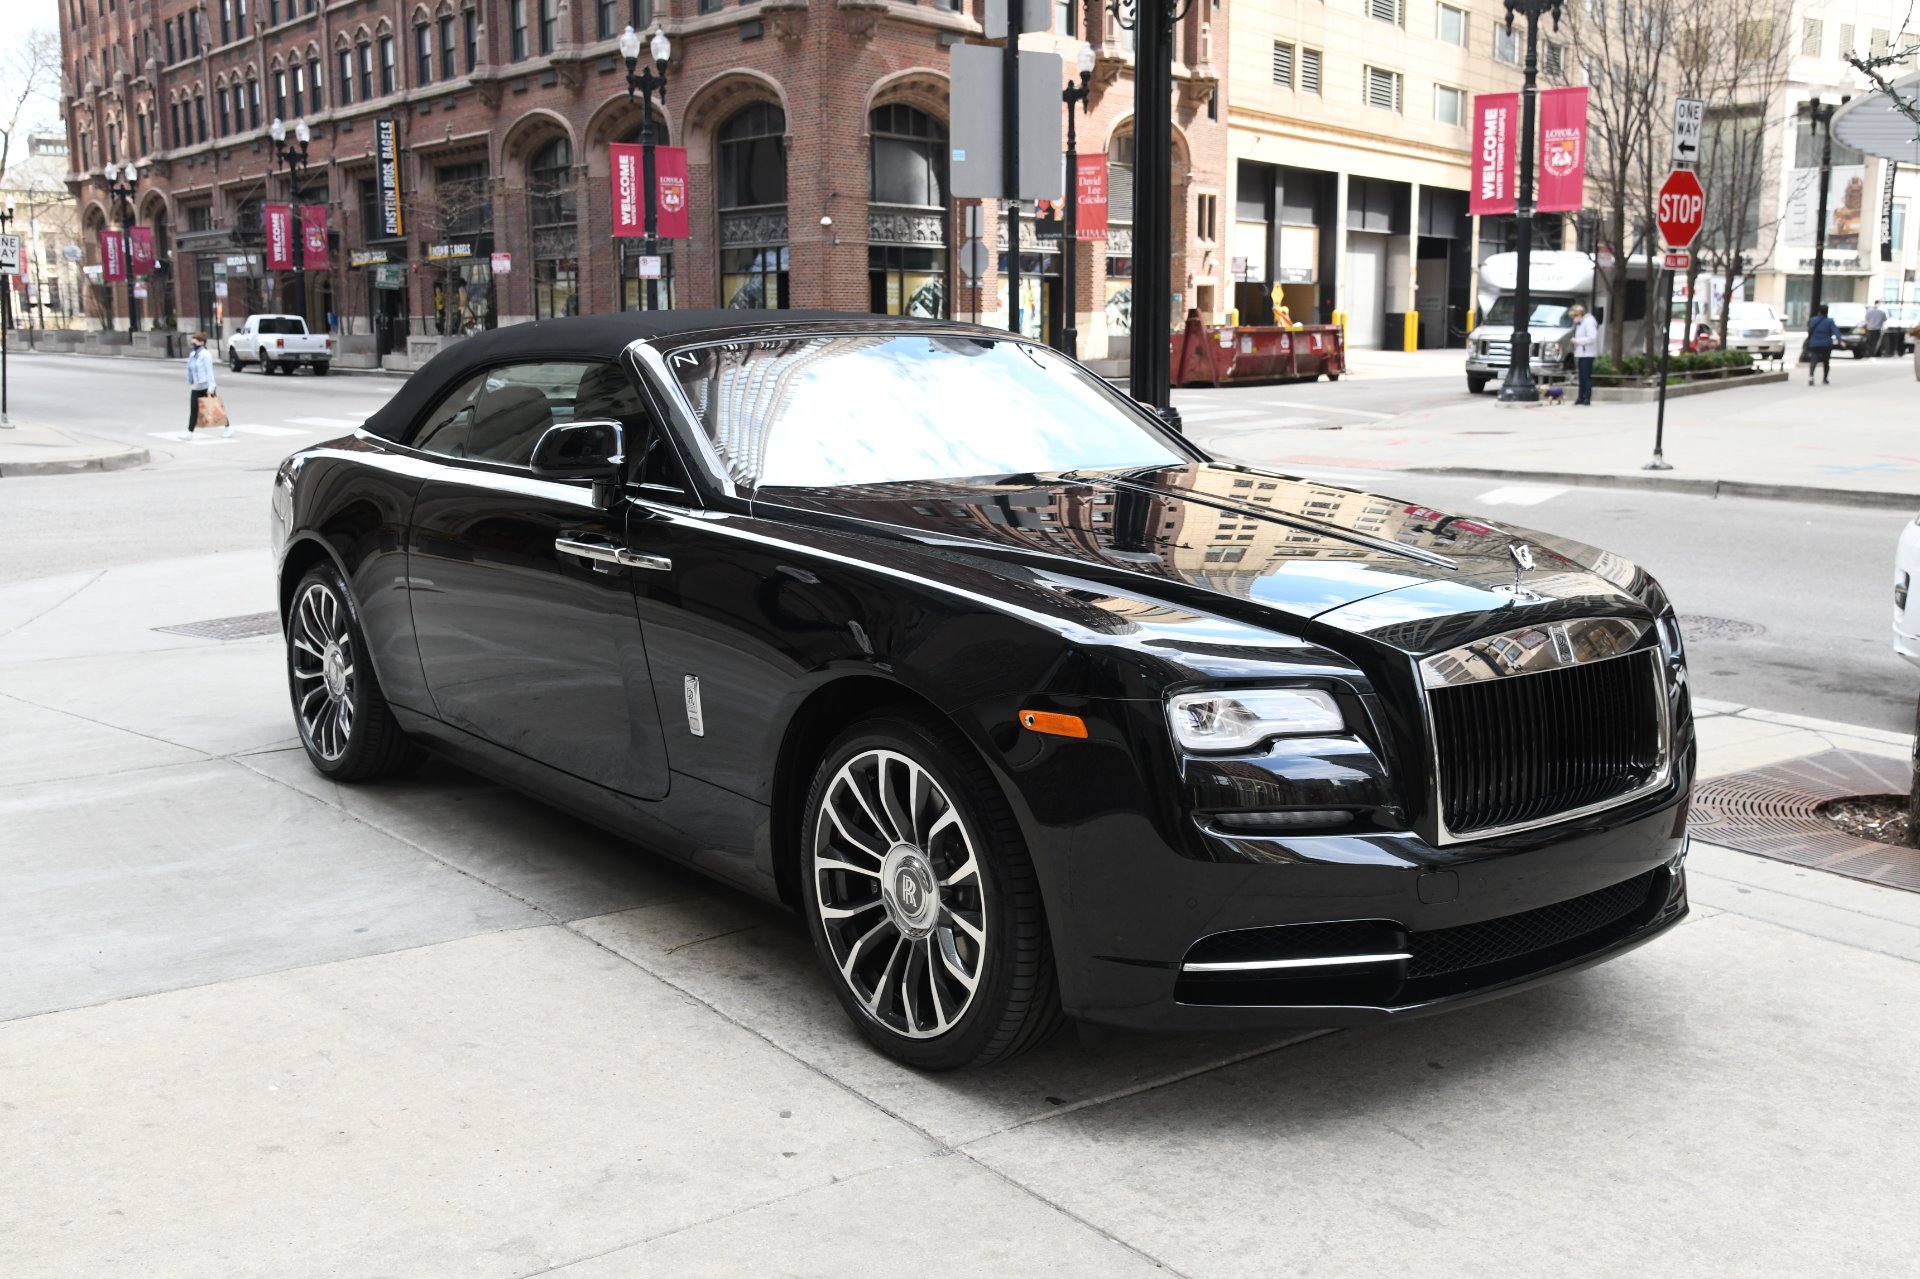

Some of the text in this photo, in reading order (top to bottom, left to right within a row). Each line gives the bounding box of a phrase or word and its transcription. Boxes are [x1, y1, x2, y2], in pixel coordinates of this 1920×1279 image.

[1678, 104, 1700, 120] ONE
[1545, 128, 1581, 138] LOYOLA
[1677, 121, 1699, 136] WAY
[1481, 108, 1498, 200] WELCOME
[1496, 108, 1507, 200] WATER TOWER CAMPUS
[380, 122, 398, 234] EINSTEIN BROS. BAGELS
[659, 176, 684, 184] LOYOLA
[1079, 176, 1101, 187] David
[618, 154, 632, 226] WELCOME
[1087, 186, 1101, 195] Lee
[1659, 193, 1702, 224] STOP
[1, 237, 16, 248] NE
[271, 213, 281, 262] WELCOME
[1, 249, 16, 258] AY
